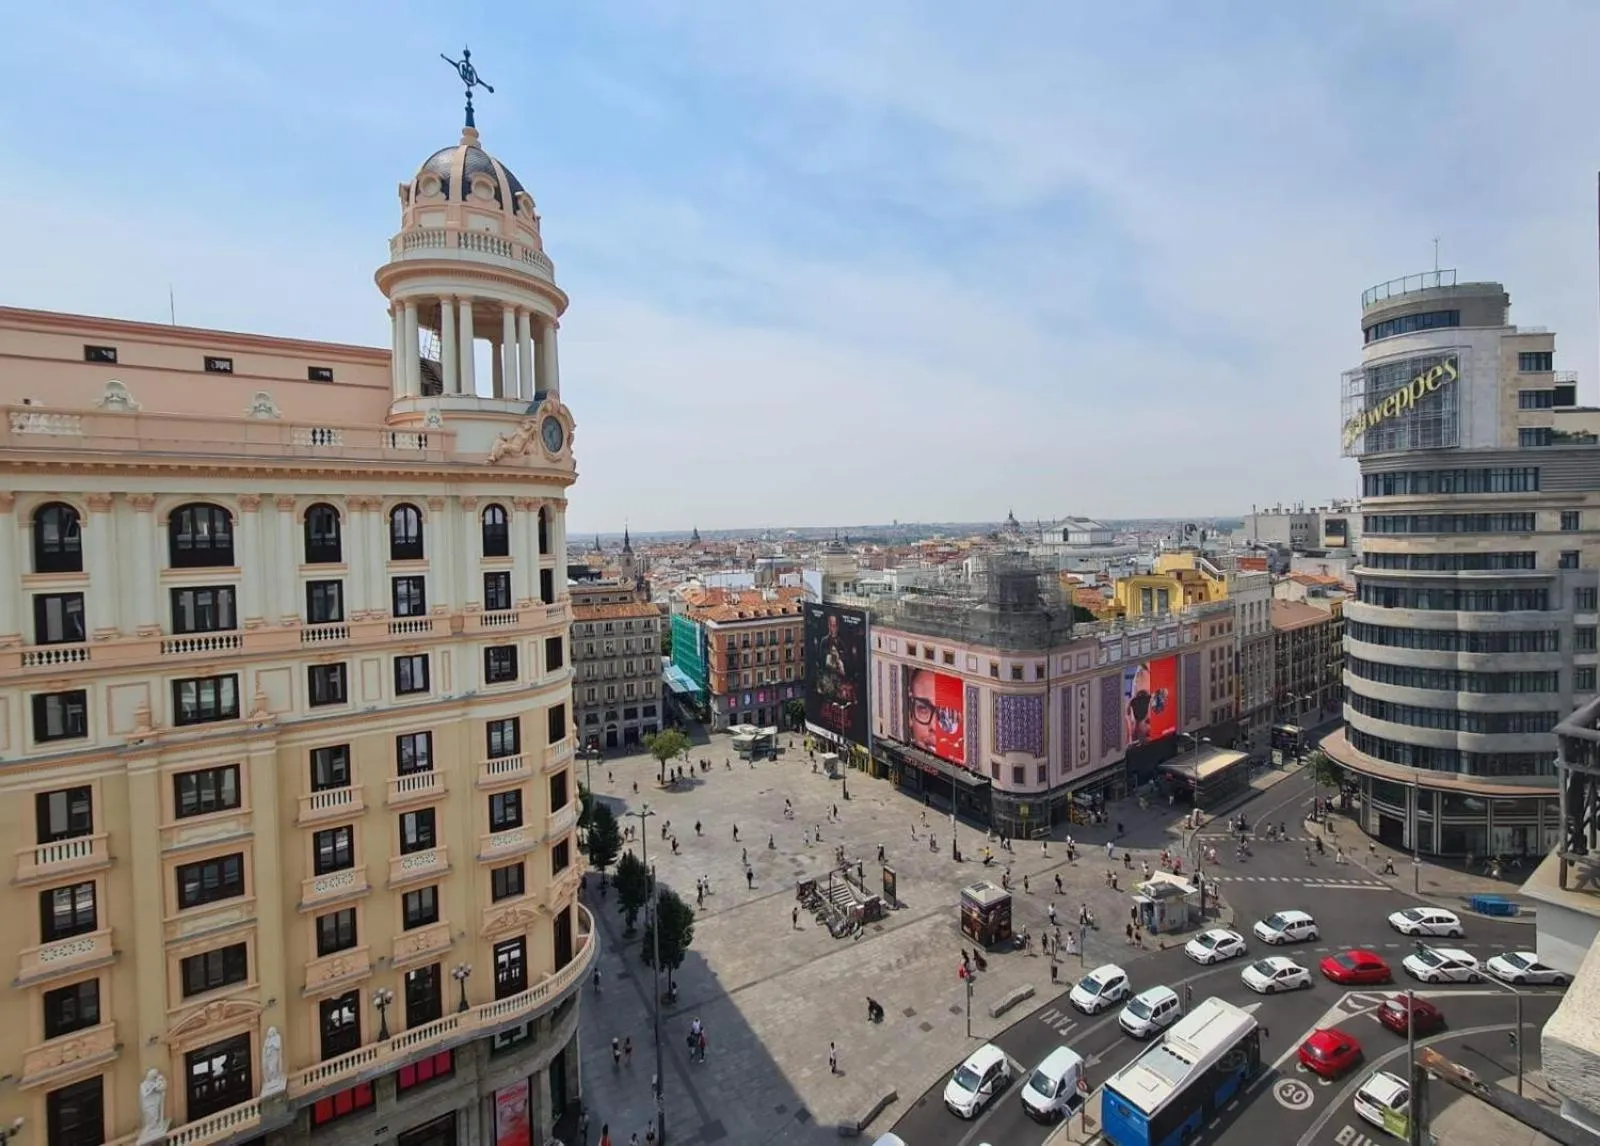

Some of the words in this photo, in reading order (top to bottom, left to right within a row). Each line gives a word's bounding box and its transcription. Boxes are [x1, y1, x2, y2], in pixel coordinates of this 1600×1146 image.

[1079, 686, 1087, 761] CALLAO
[1039, 1008, 1079, 1036] TAXI
[1281, 1084, 1306, 1104] 30
[1333, 1124, 1381, 1146] BU
